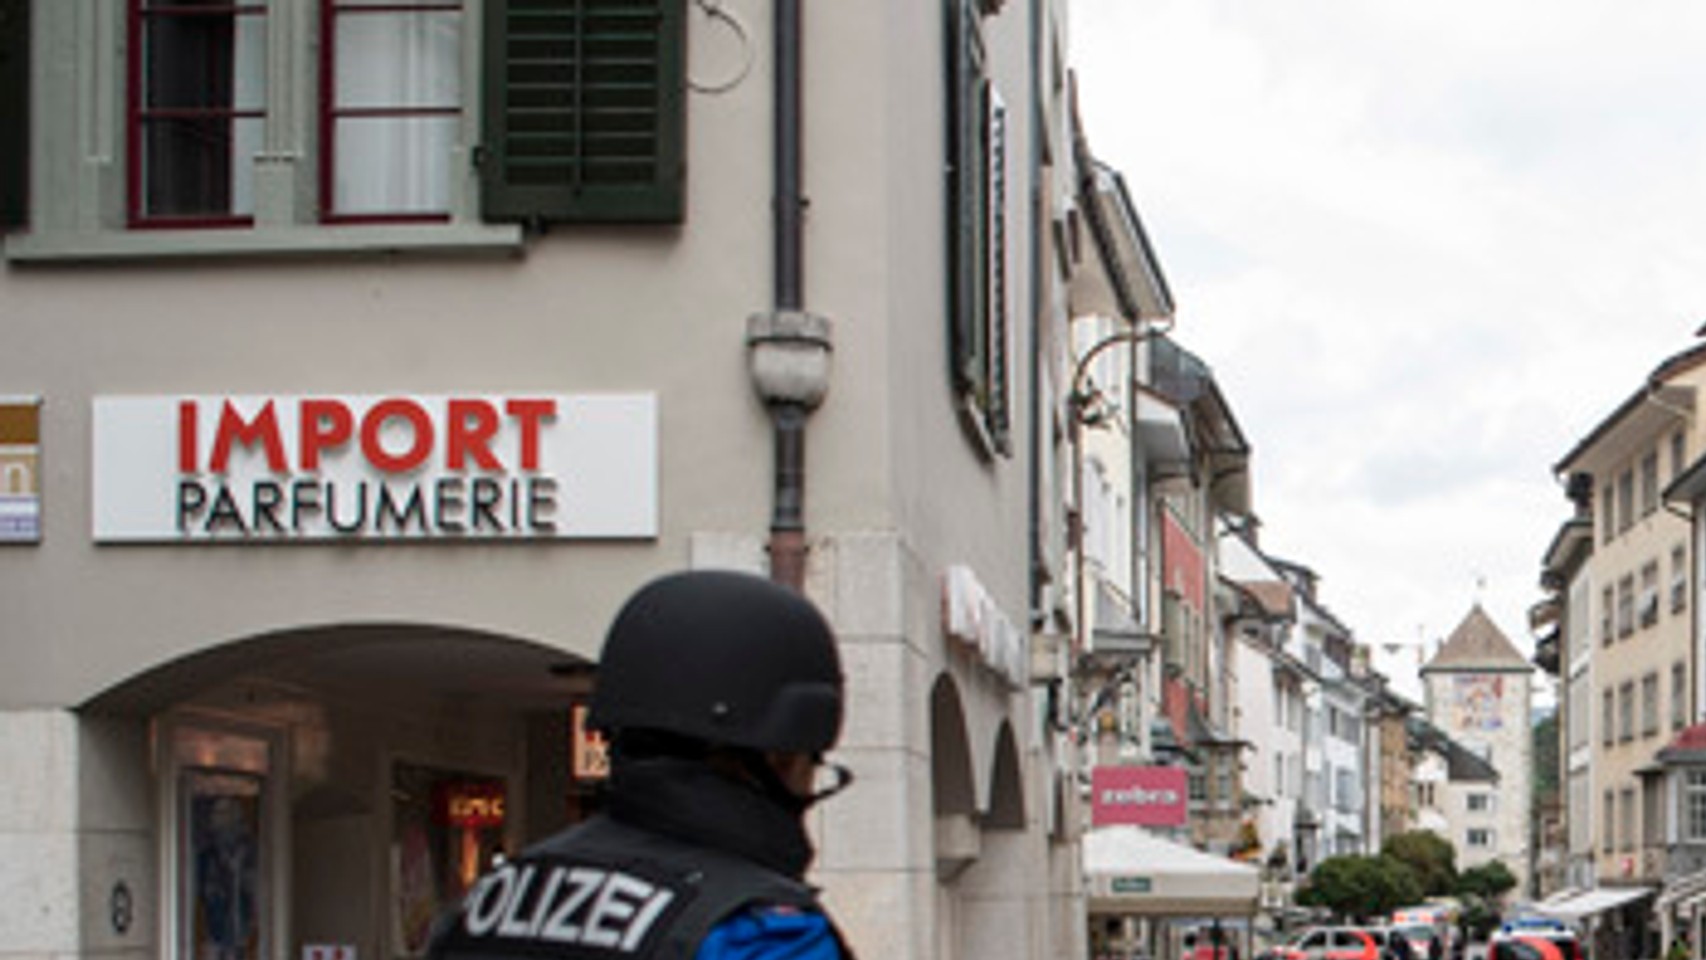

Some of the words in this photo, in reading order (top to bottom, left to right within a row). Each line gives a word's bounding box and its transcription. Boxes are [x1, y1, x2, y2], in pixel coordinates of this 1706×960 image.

[179, 399, 557, 474] IMPORT
[175, 480, 558, 534] PARFUMERIE
[463, 864, 675, 952] OLIZEI
